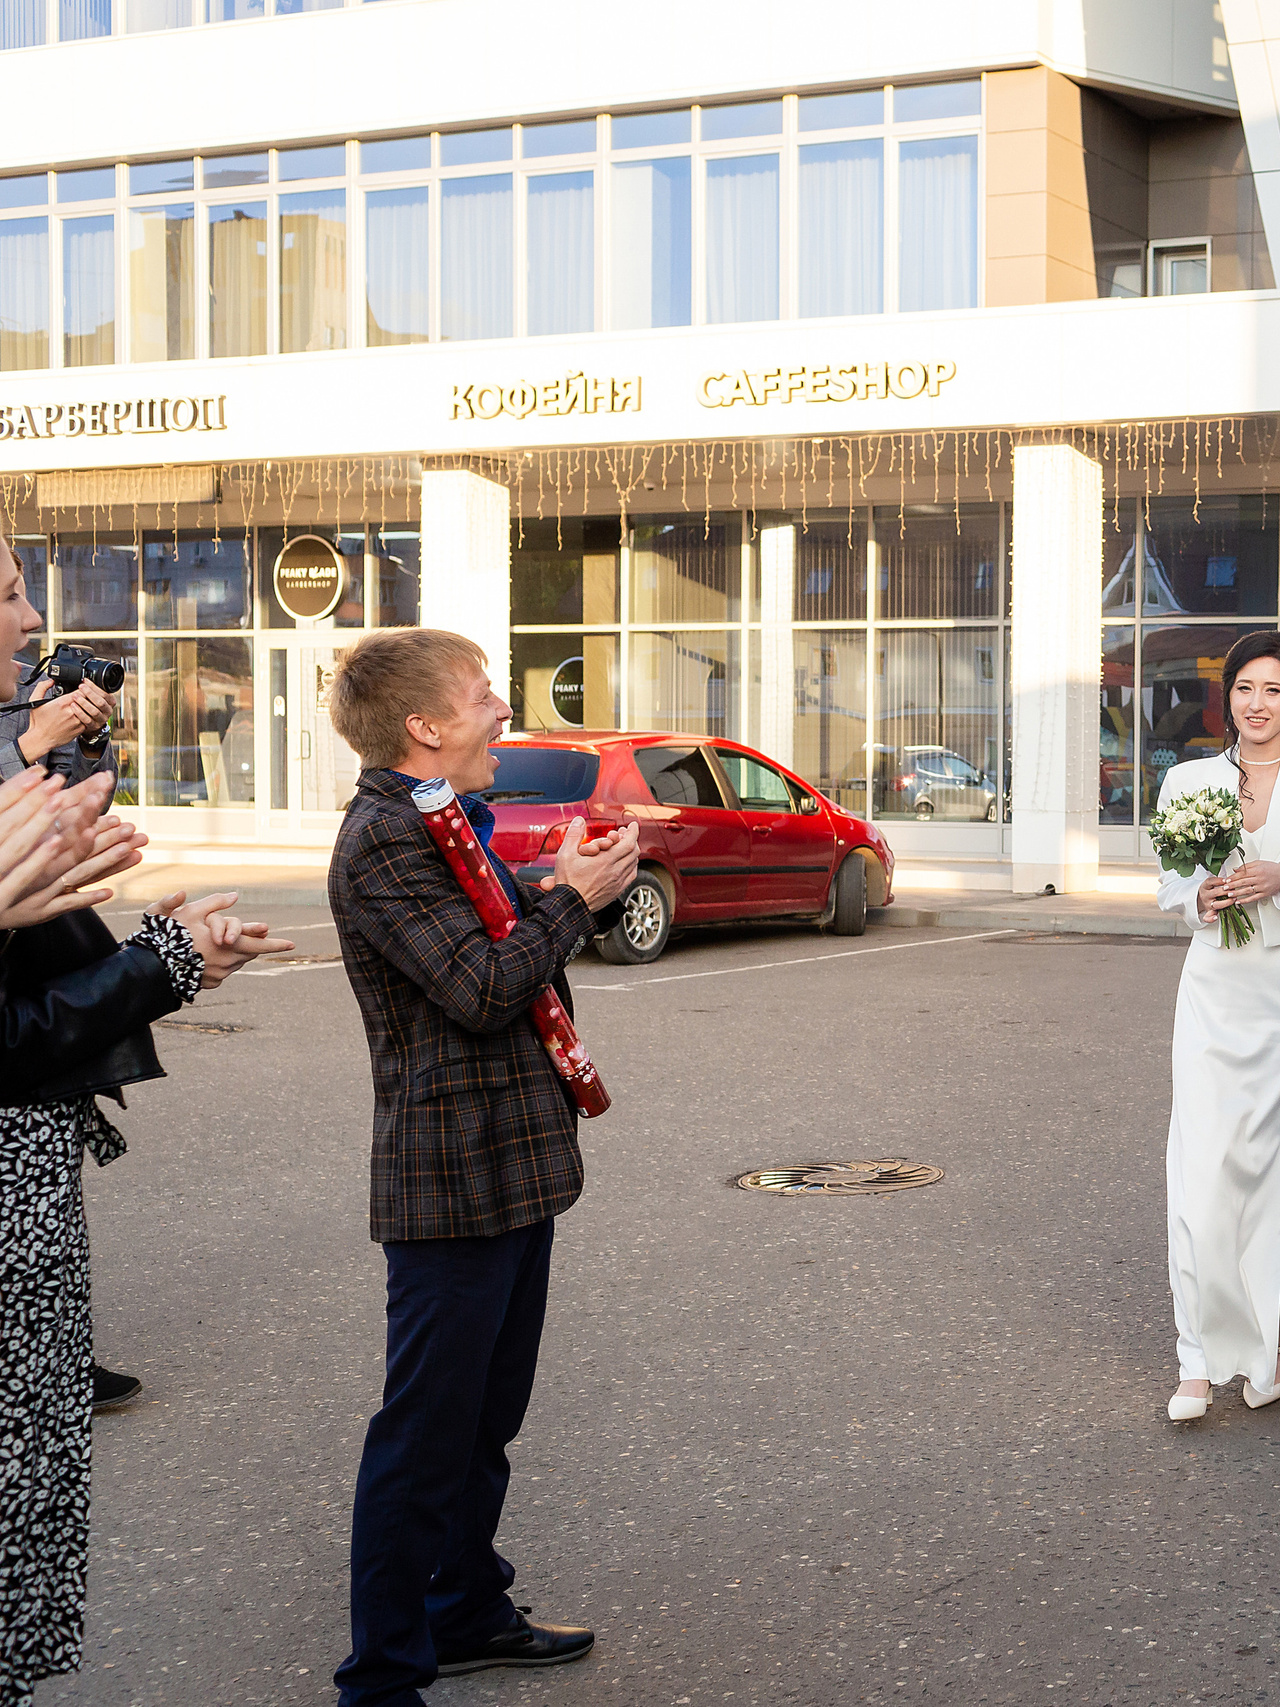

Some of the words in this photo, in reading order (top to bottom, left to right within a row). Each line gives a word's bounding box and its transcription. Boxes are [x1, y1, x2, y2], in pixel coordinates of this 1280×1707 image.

[448, 368, 643, 421] КОФЕЙНЯ
[696, 358, 957, 409] CAFFESHOP
[0, 394, 228, 440] БАРБЕРШОП
